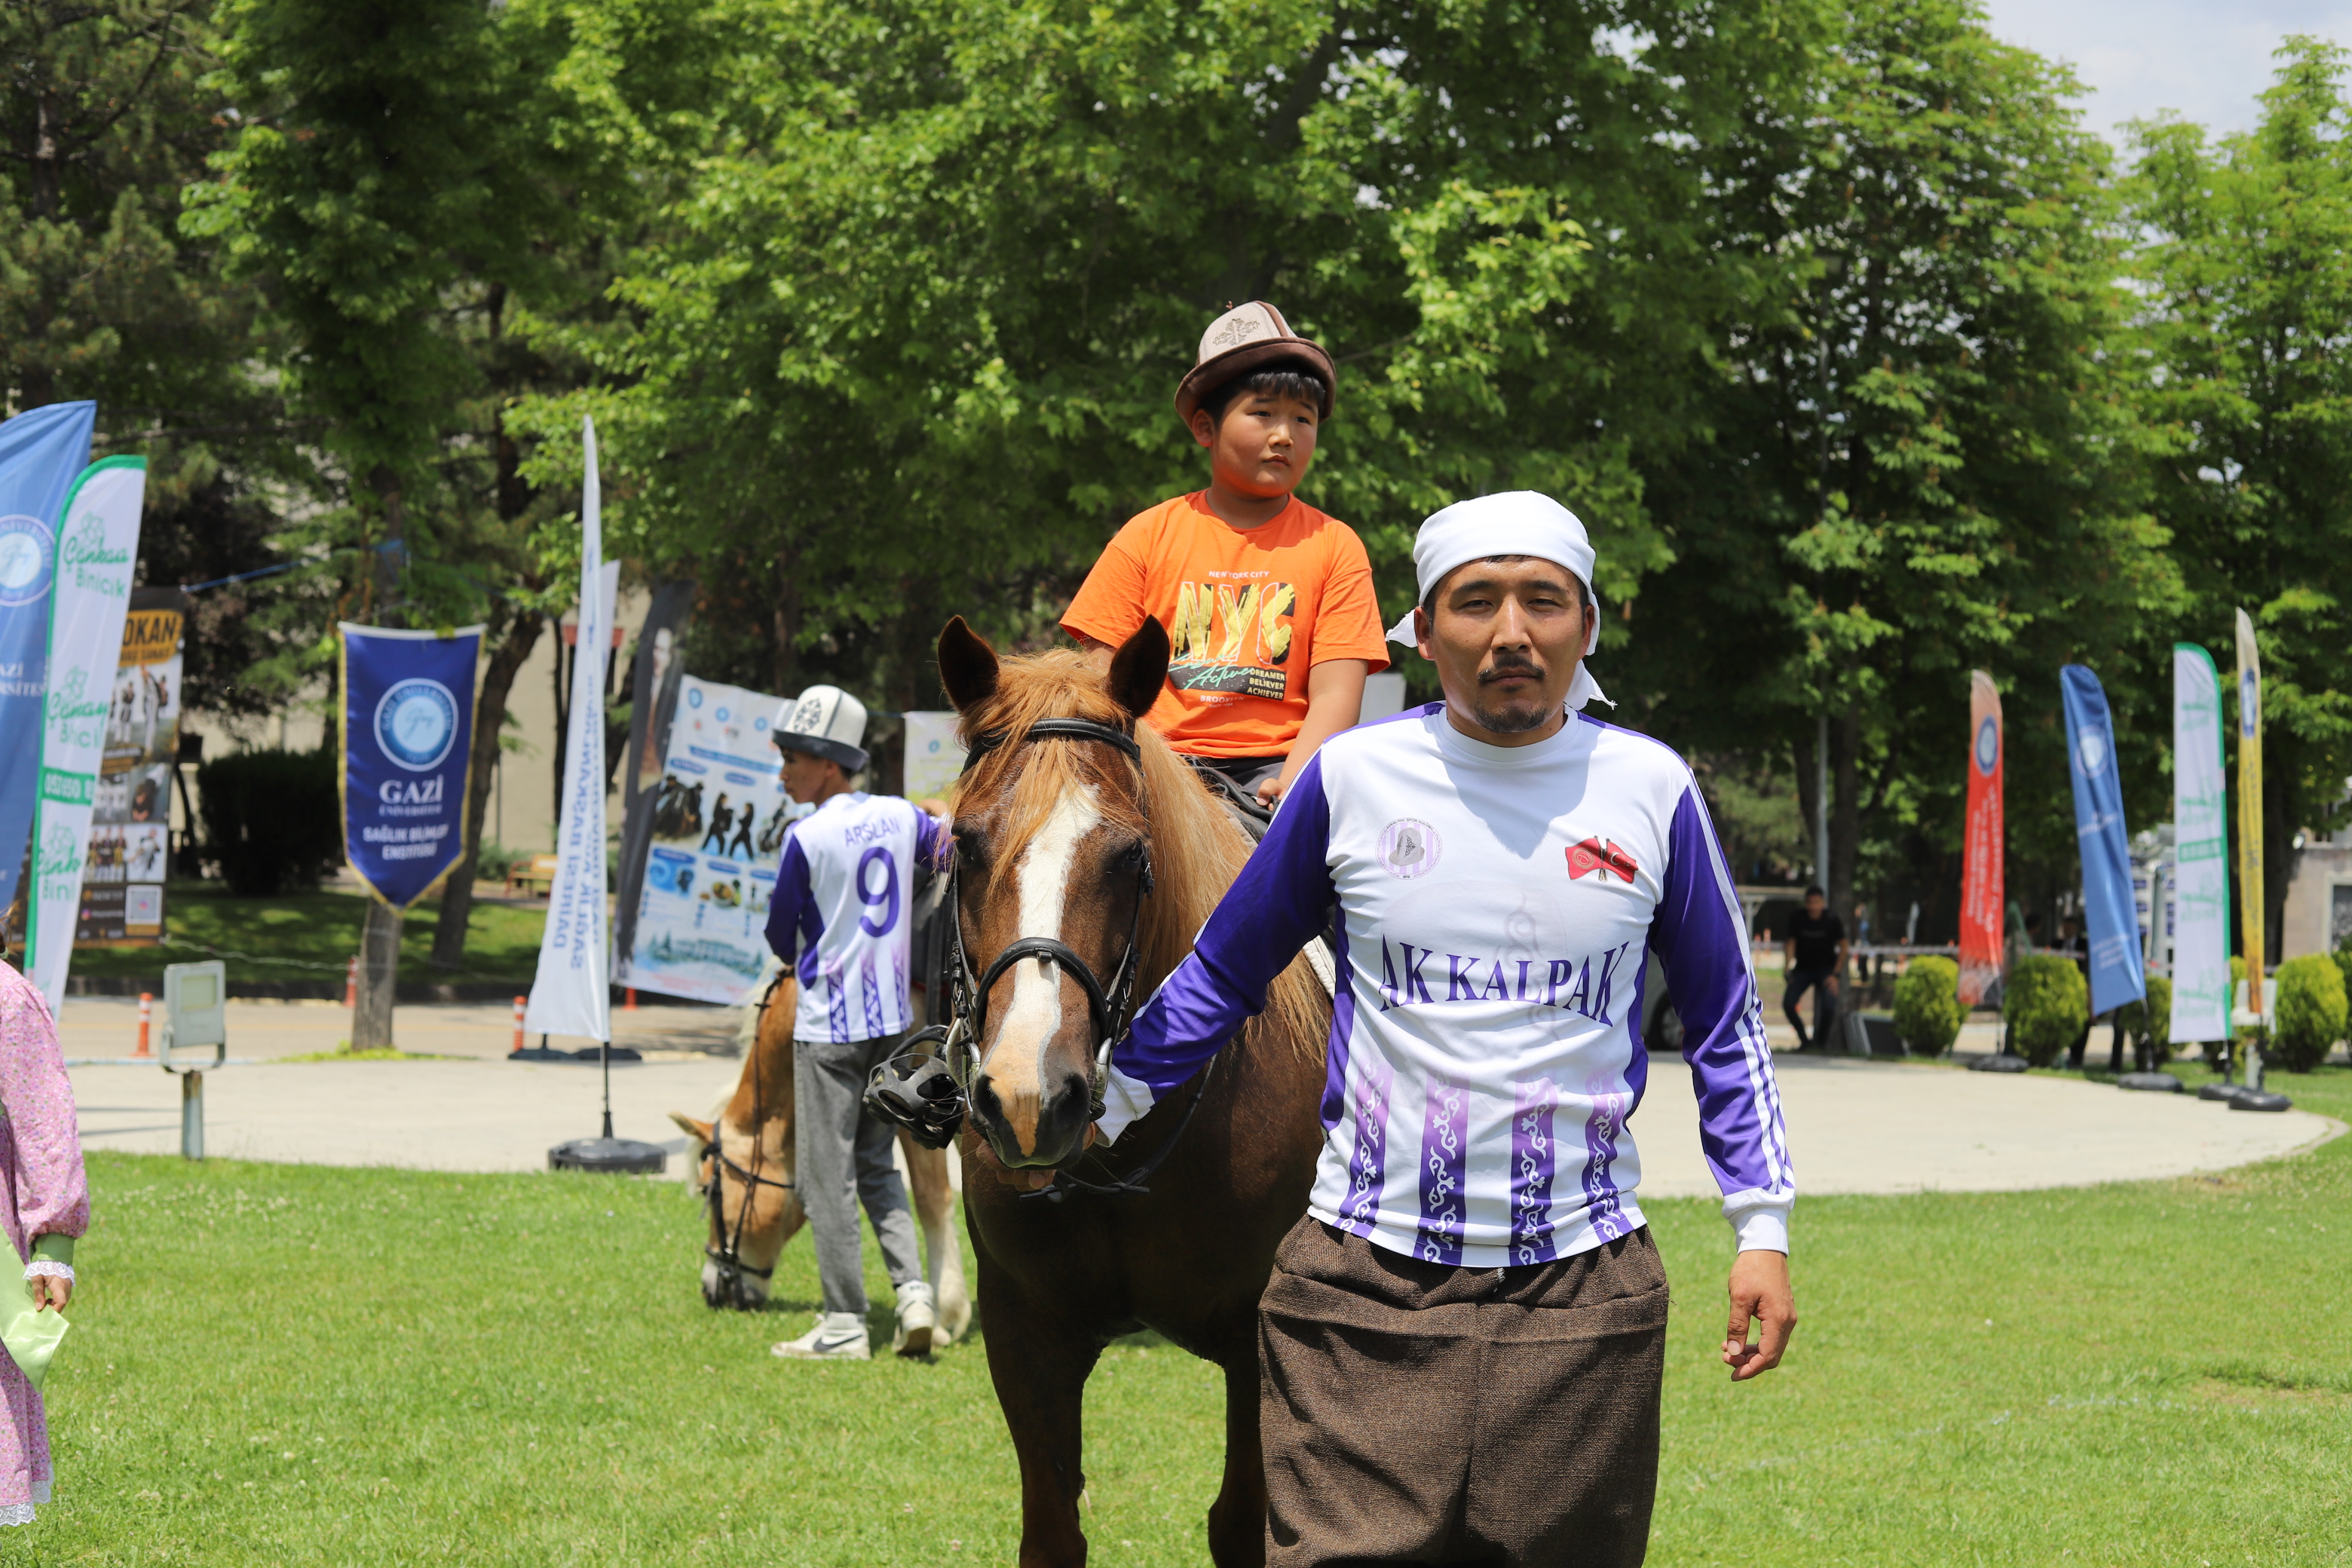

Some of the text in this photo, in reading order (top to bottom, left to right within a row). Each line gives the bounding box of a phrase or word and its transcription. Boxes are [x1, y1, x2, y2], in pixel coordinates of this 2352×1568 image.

[1228, 571, 1248, 579] YORK
[1171, 581, 1296, 665] NYC
[1249, 678, 1285, 690] BELIEVER
[1250, 669, 1285, 681] DREAMER
[1247, 687, 1284, 700] ACHIEVER
[378, 773, 443, 804] GAZİ
[844, 817, 901, 847] ARSLAN
[857, 847, 899, 937] 9
[1379, 934, 1630, 1027] AK KALPAK
